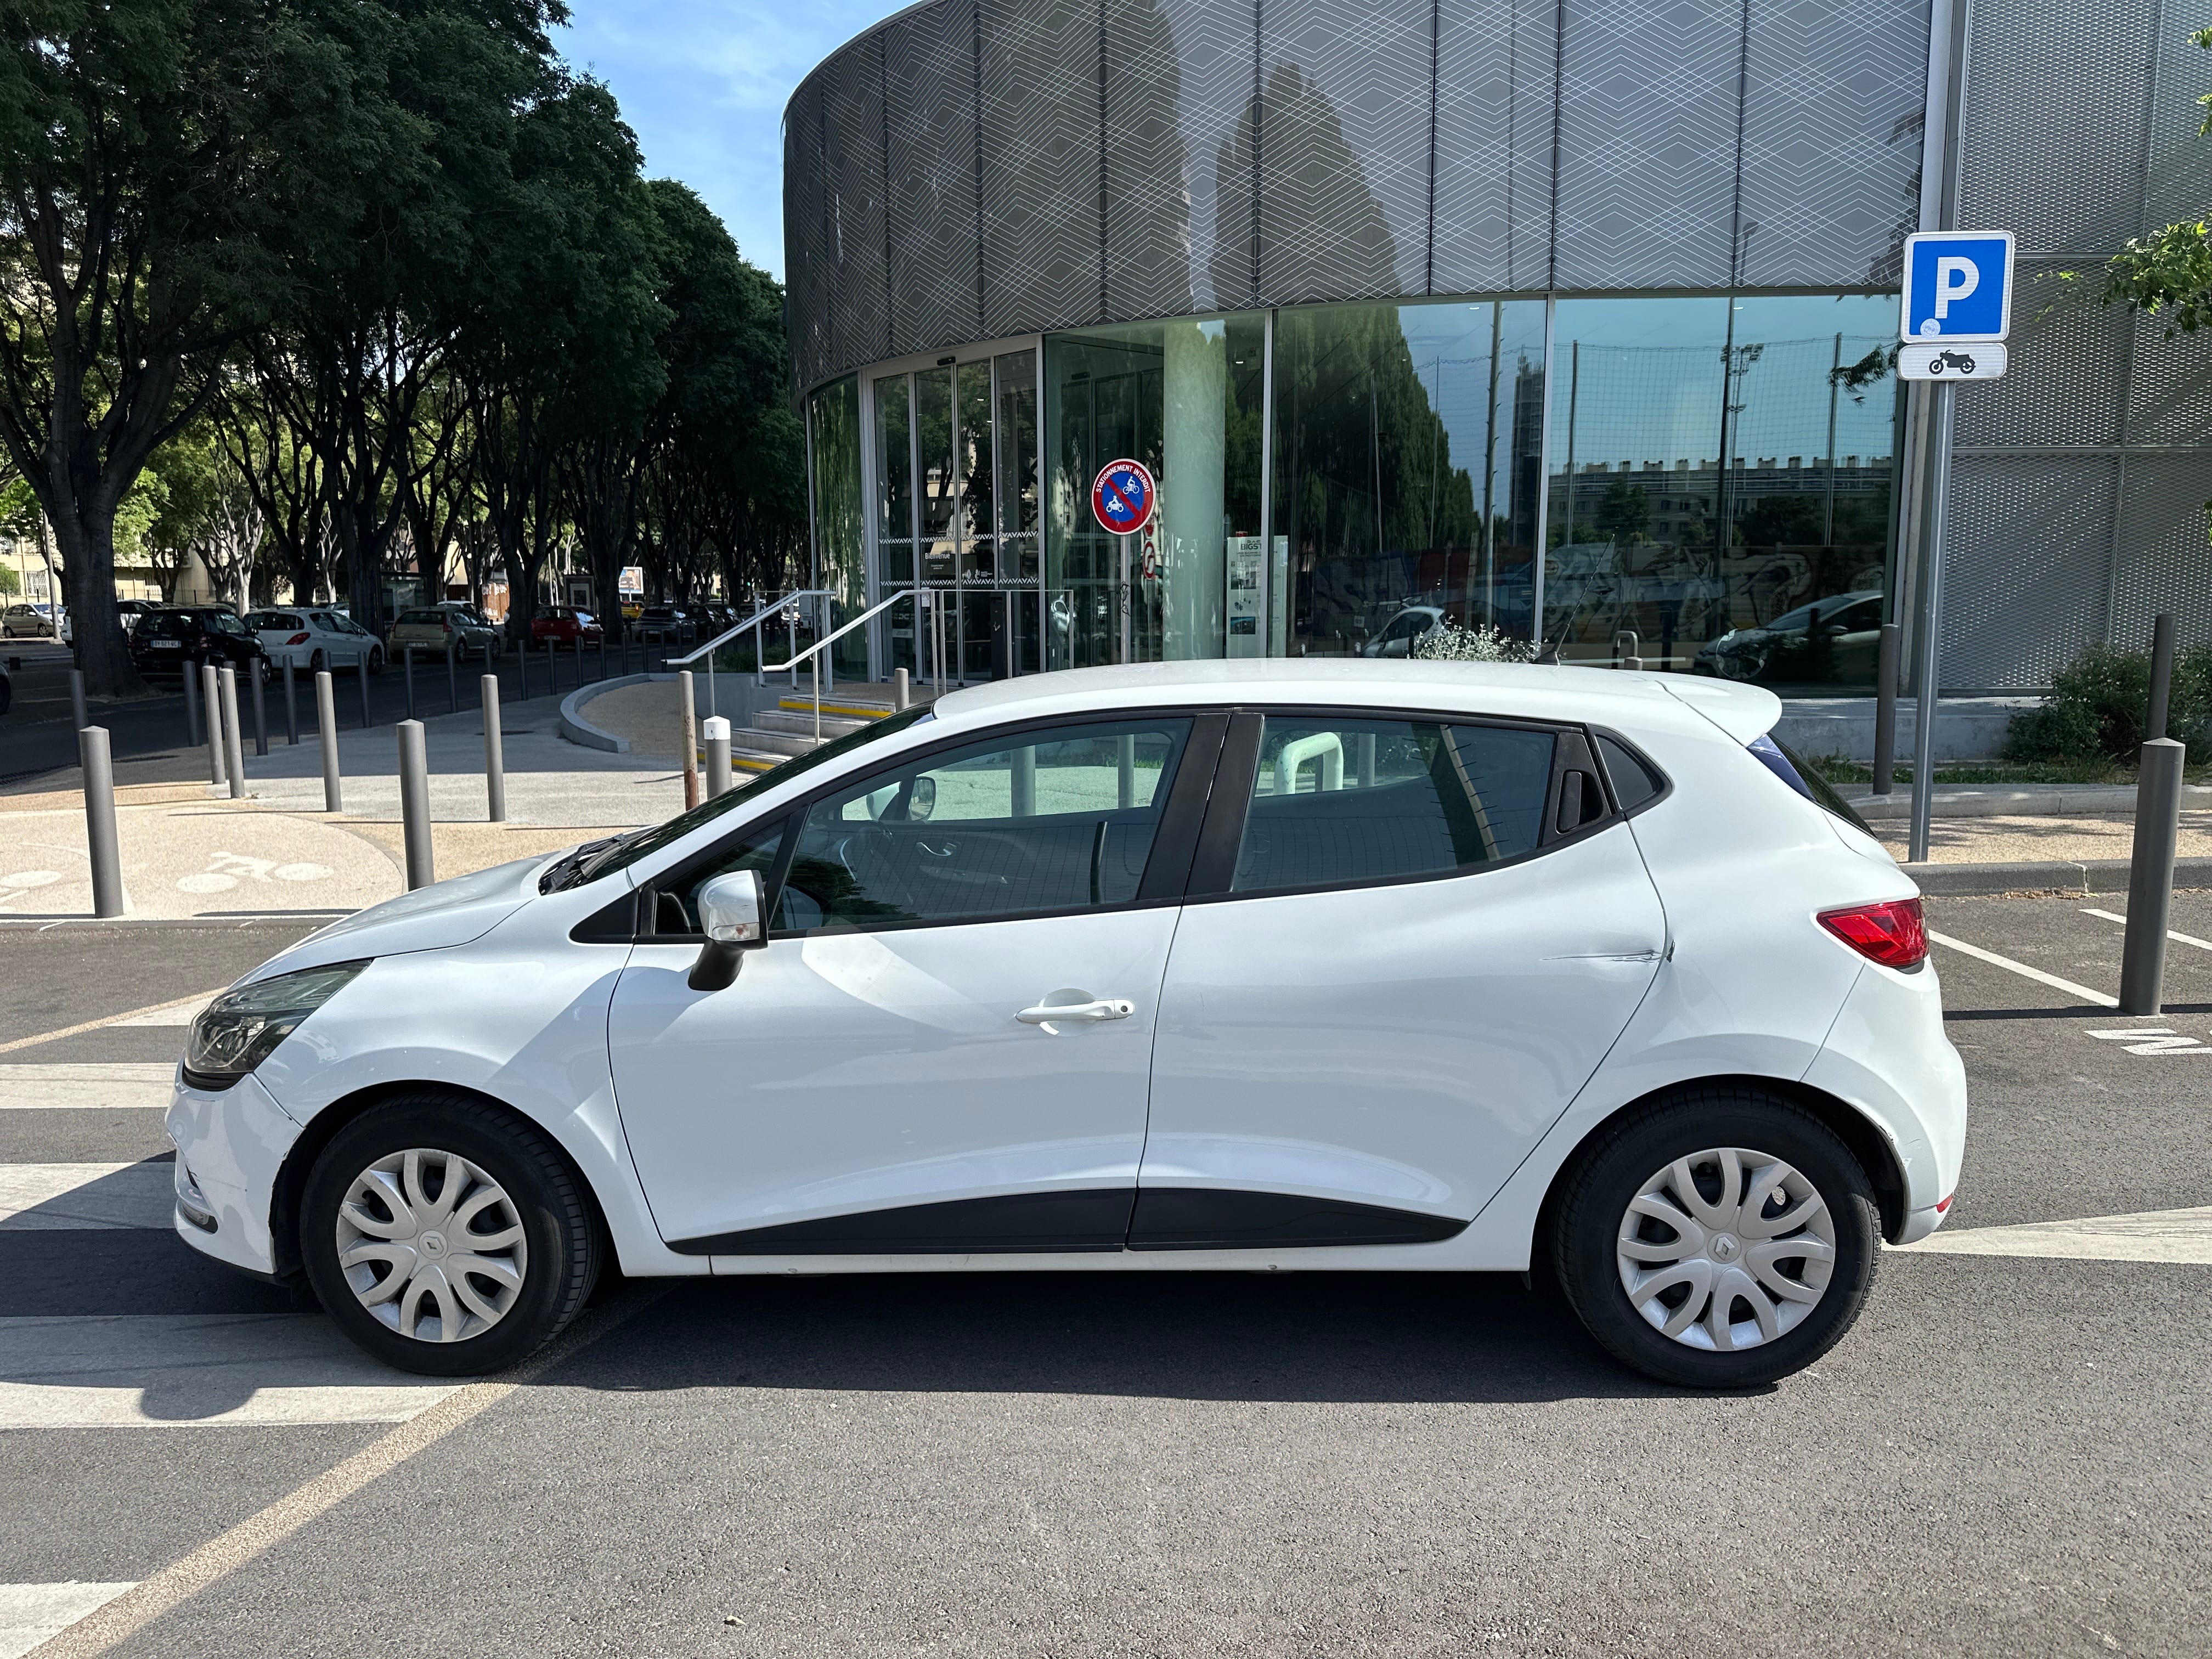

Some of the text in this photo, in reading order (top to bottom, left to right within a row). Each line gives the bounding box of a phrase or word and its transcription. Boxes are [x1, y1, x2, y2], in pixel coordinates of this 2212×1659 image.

[1934, 256, 1979, 319] P
[1096, 465, 1151, 493] STATIONNEMENT INTERDIT
